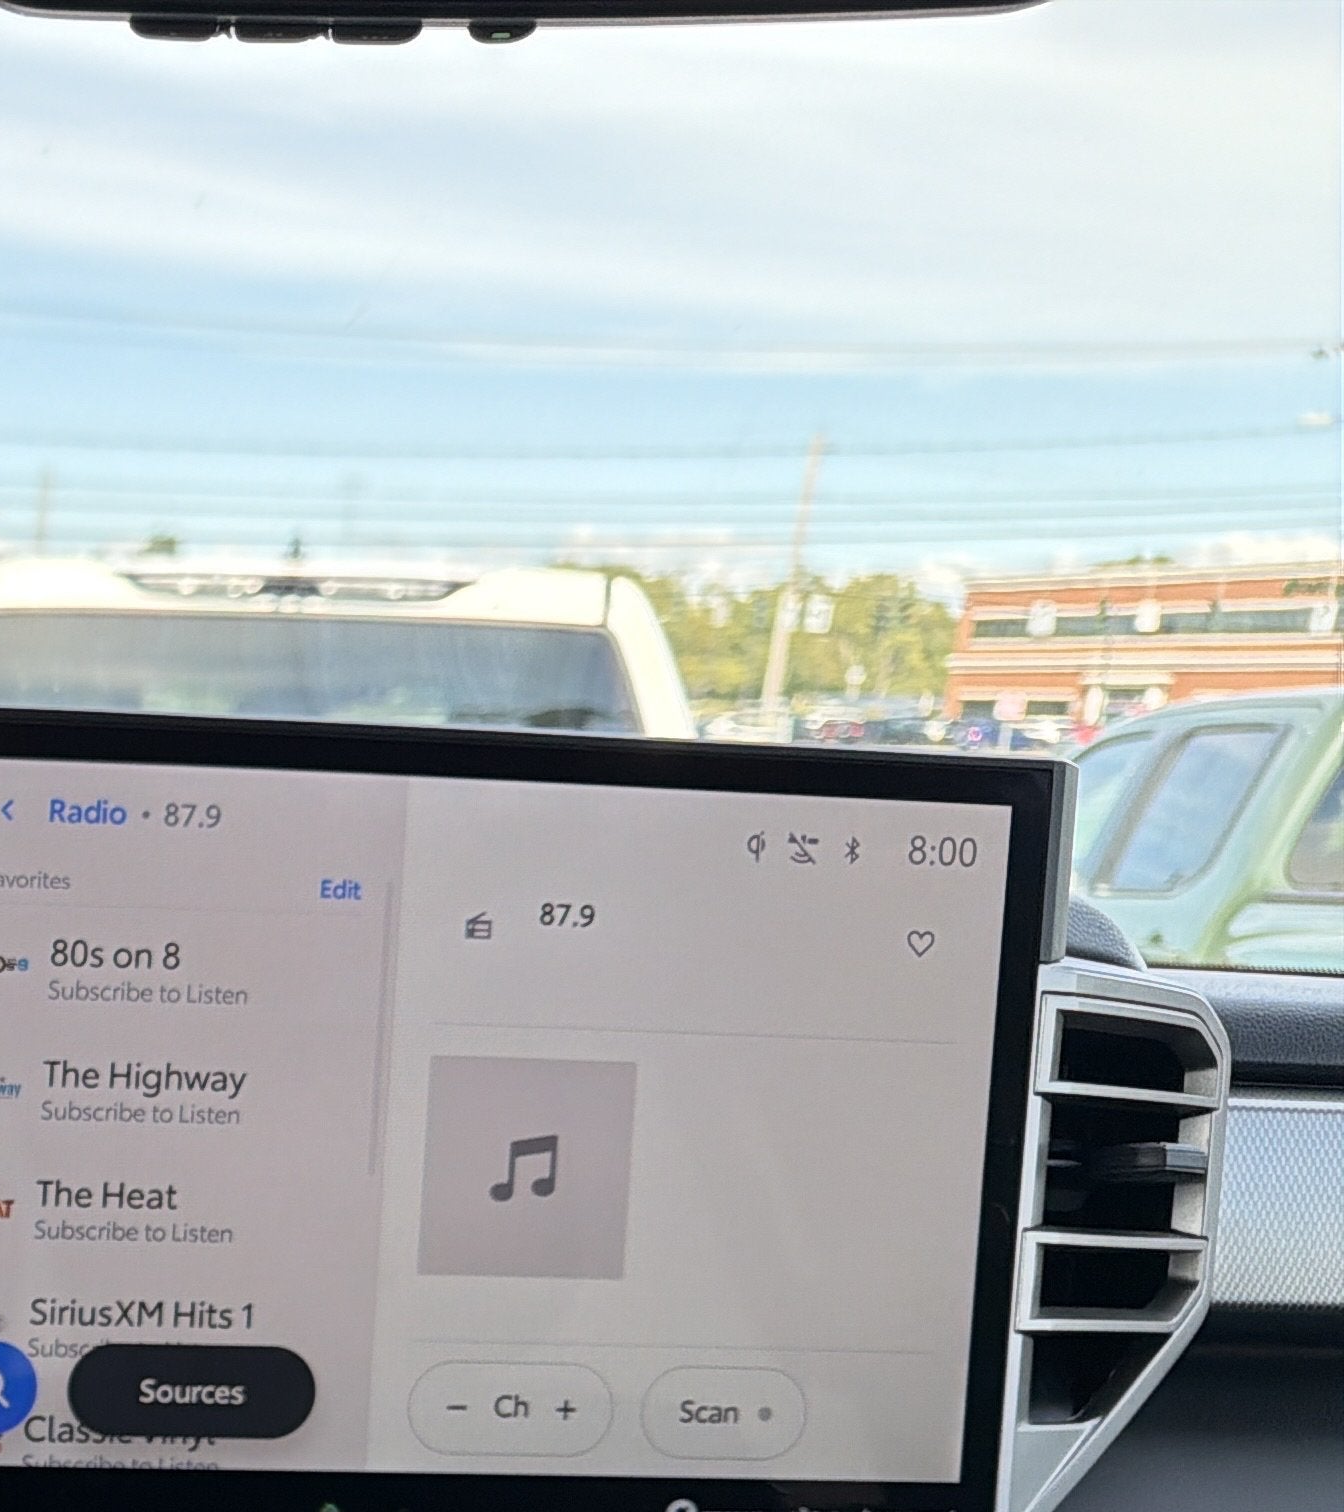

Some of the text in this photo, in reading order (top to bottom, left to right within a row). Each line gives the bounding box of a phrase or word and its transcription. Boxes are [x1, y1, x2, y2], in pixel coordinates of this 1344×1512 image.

[48, 798, 222, 830] Radio 87.9
[907, 836, 978, 868] 8:00
[319, 879, 362, 901] Edit
[538, 902, 596, 928] 87.9
[50, 939, 105, 968] 80s
[112, 948, 157, 969] on
[162, 942, 181, 970] 8
[48, 980, 249, 1005] Subscribe to Listen
[42, 1060, 248, 1098] The Highway
[40, 1101, 241, 1126] Subscribe to Listen
[36, 1180, 178, 1211] The Heat
[33, 1220, 234, 1245] Subscribe to Listen
[28, 1298, 254, 1331] SiriusXM Hits 1
[27, 1337, 94, 1359] Subsc
[138, 1378, 245, 1406] Sources
[493, 1394, 530, 1420] Ch
[679, 1400, 739, 1425] Scan
